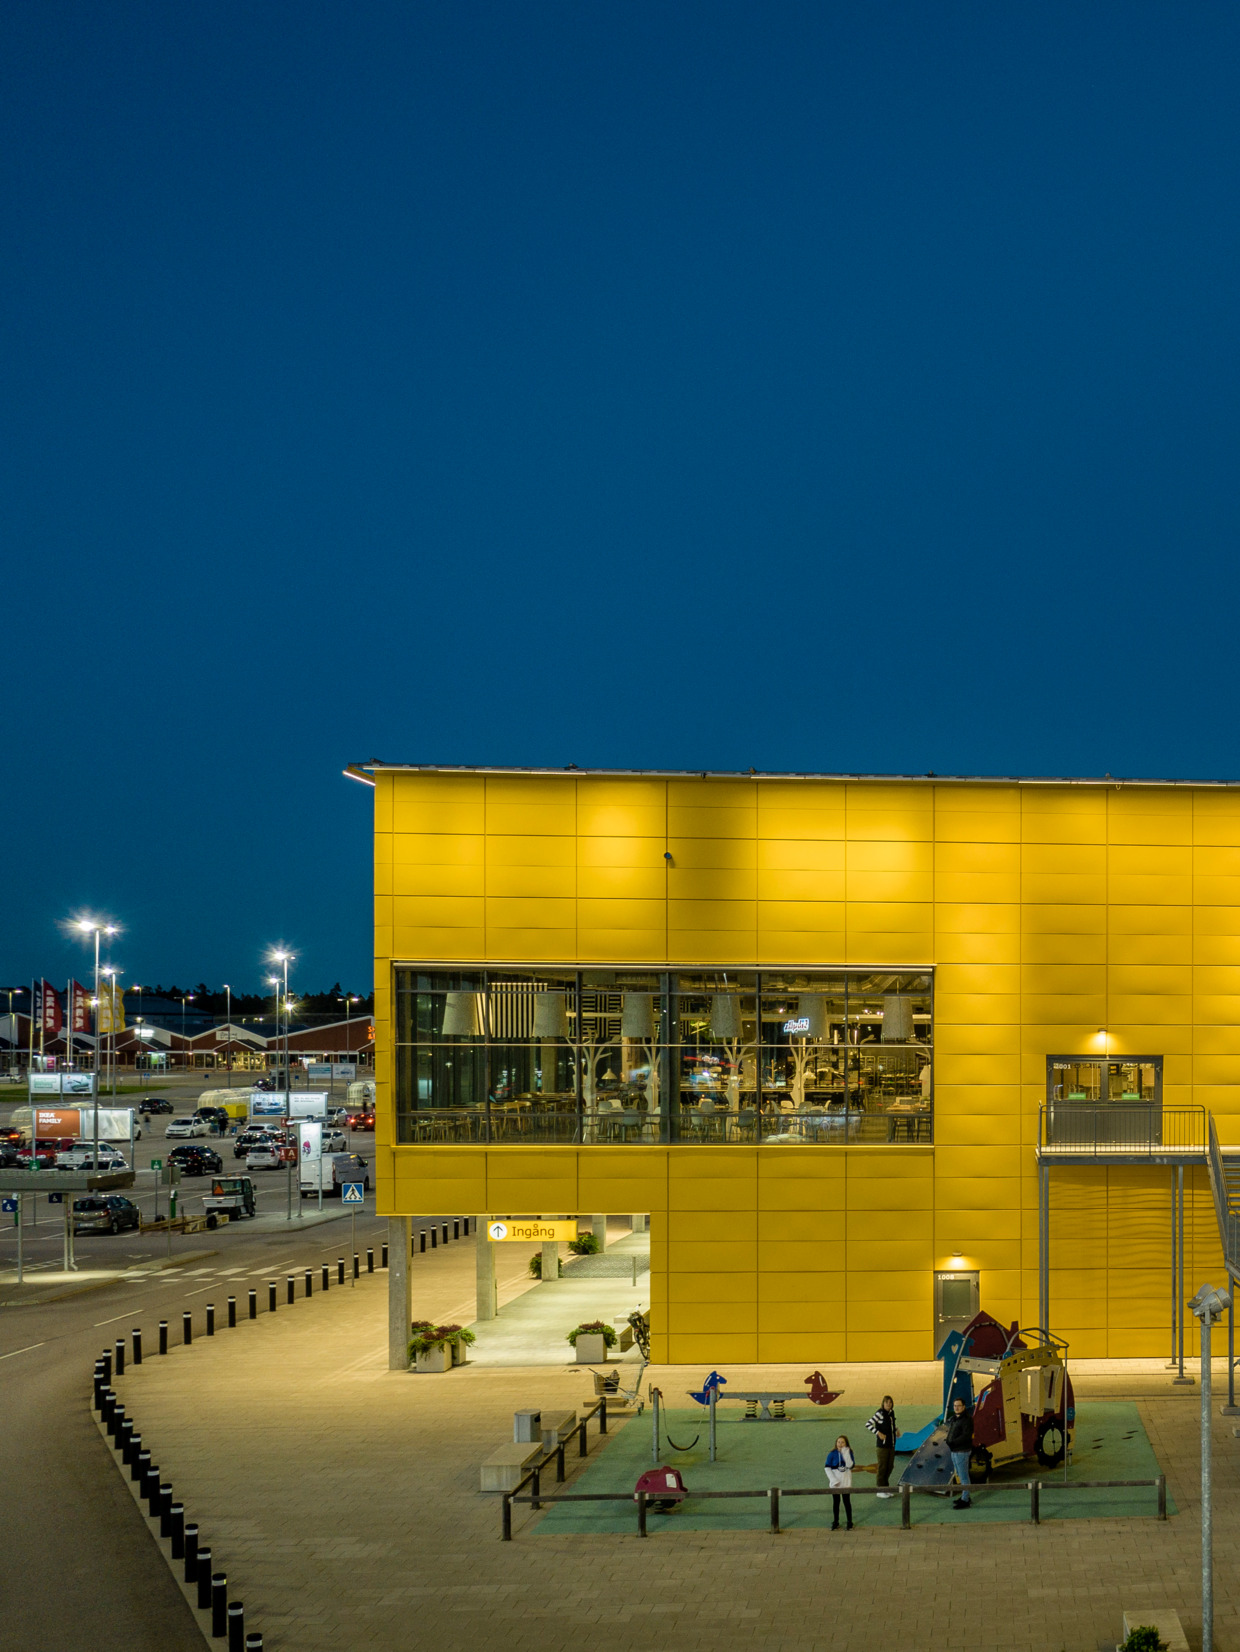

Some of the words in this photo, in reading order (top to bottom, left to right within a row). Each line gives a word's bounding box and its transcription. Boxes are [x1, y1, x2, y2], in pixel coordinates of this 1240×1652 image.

[46, 990, 55, 1028] IKEA
[75, 990, 84, 1028] IKEA
[512, 1223, 555, 1239] Ingång
